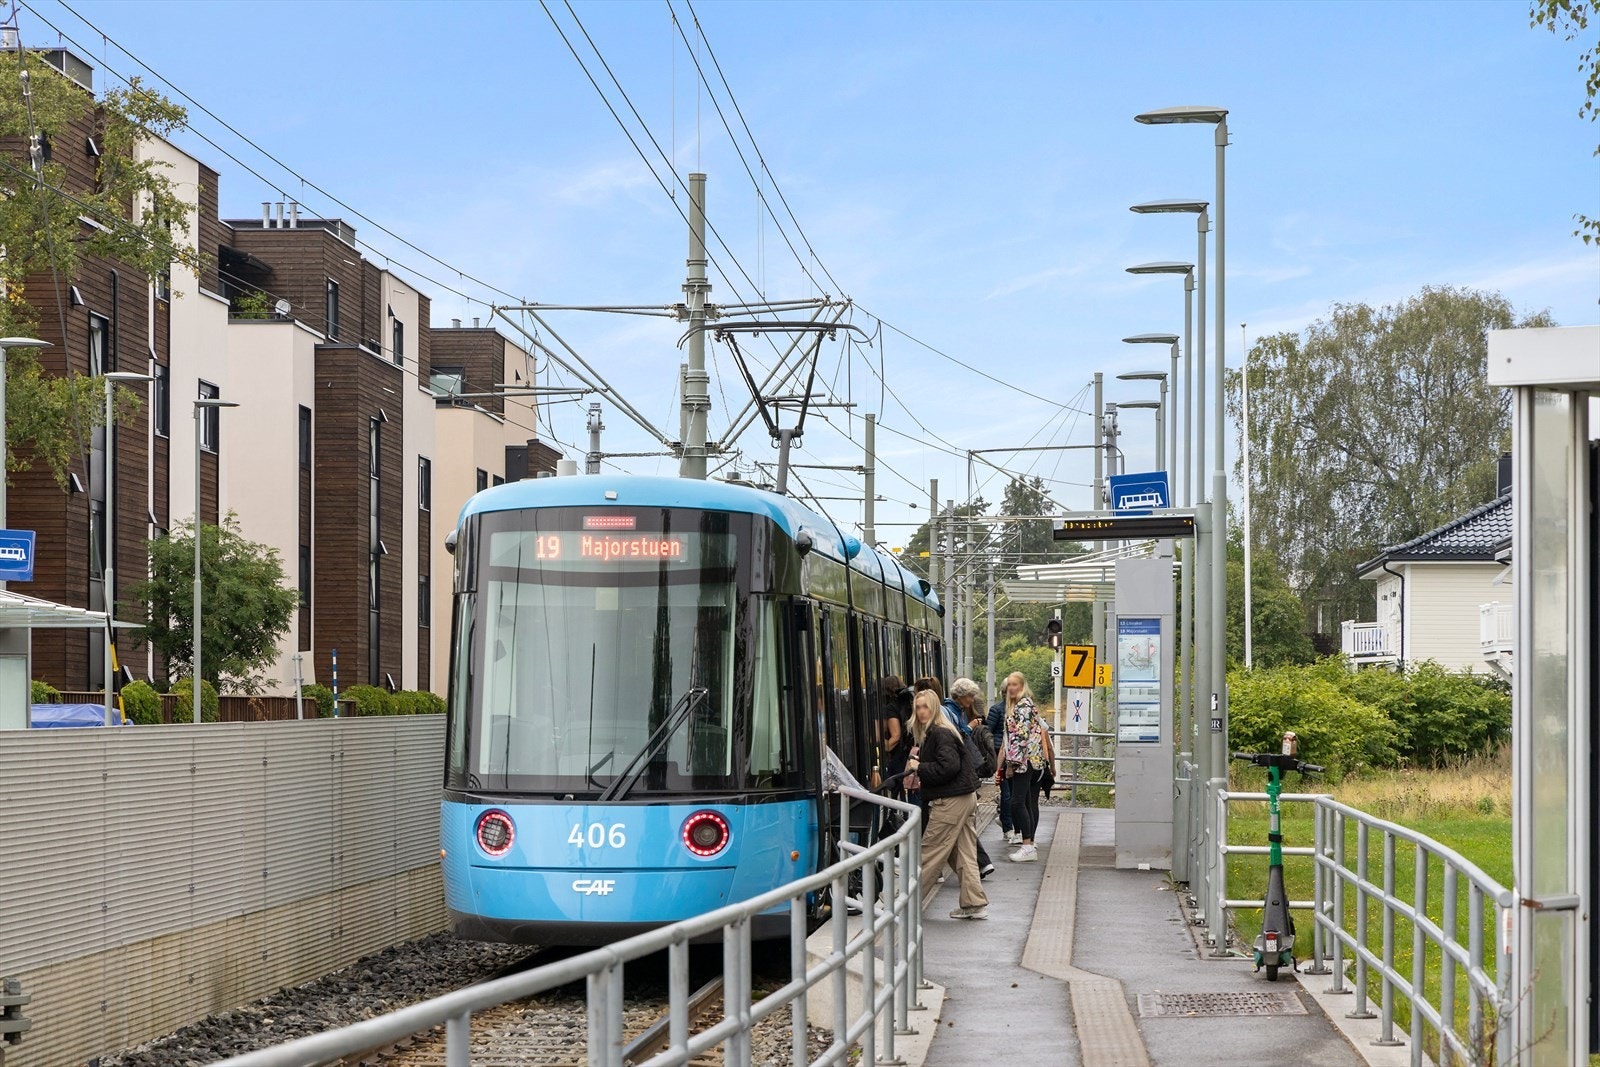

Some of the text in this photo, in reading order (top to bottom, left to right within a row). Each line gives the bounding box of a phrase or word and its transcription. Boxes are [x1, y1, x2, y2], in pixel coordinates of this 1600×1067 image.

[536, 536, 680, 561] 19 Majorstuen
[1053, 666, 1060, 675] S
[1070, 649, 1089, 677] 7
[567, 823, 626, 849] 406
[571, 879, 616, 896] CAF
